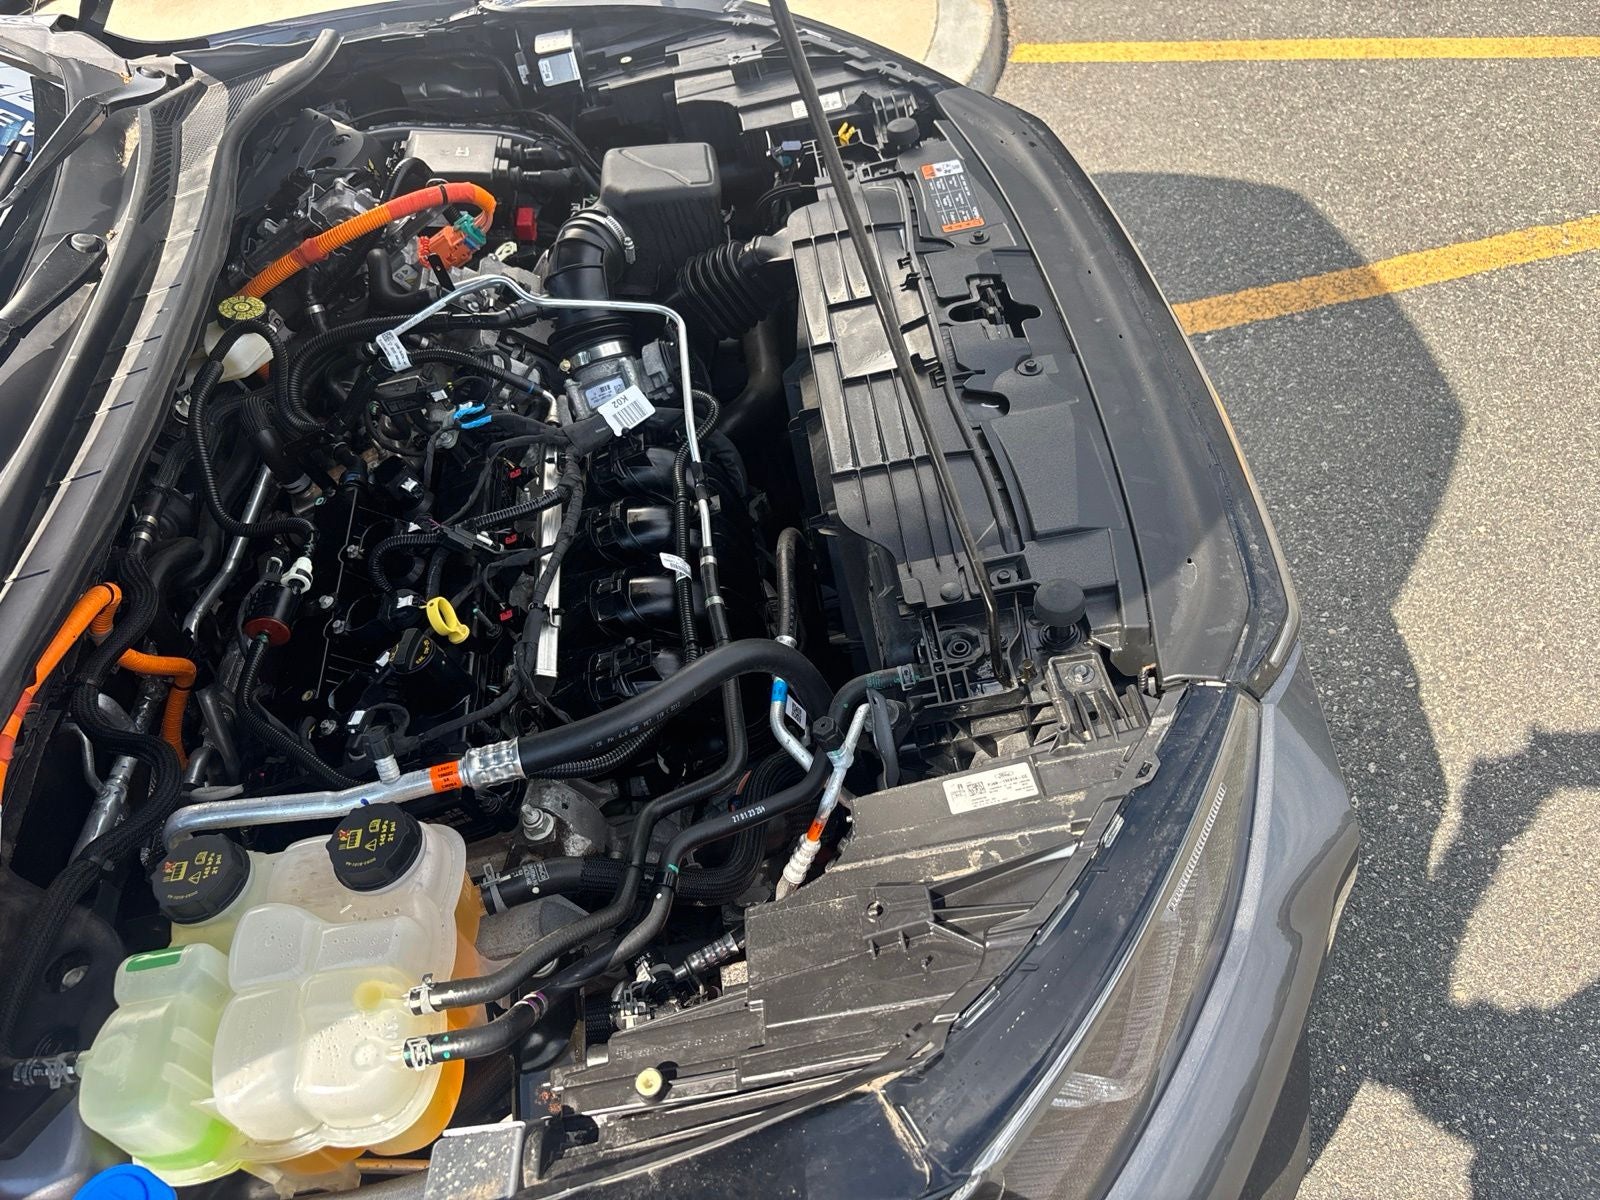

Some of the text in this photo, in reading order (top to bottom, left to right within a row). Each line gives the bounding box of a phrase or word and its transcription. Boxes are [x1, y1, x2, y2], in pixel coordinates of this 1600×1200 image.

[611, 394, 629, 409] K02
[379, 833, 387, 846] 145
[387, 833, 395, 842] 21
[211, 866, 219, 875] 21
